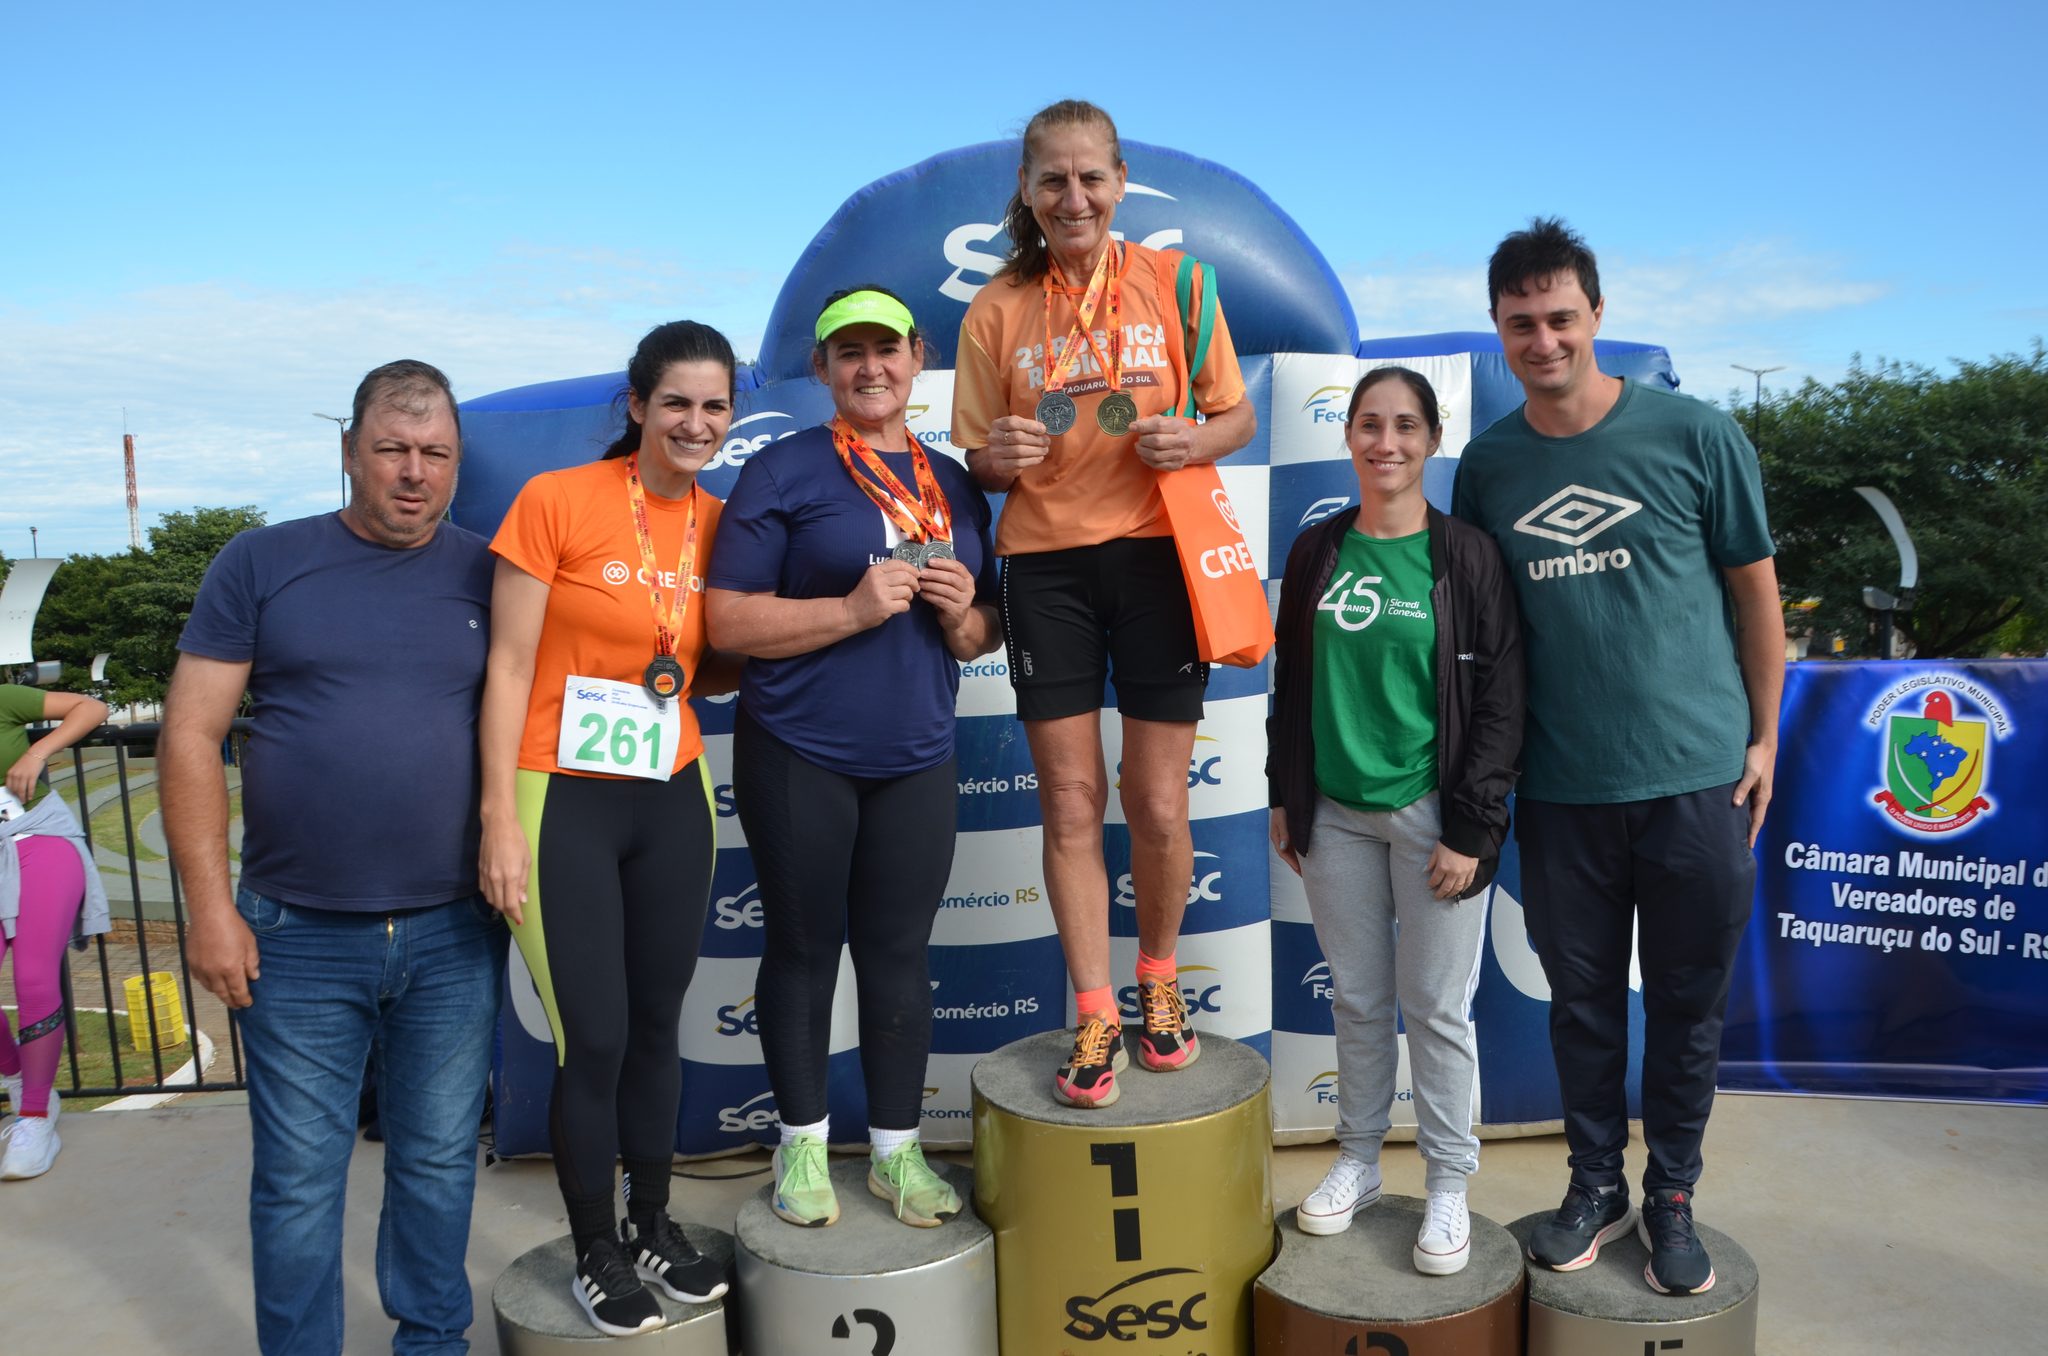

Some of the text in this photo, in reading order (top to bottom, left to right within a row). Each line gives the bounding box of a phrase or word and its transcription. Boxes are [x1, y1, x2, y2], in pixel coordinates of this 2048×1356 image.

[1135, 375, 1152, 383] SUL
[1528, 548, 1632, 581] umbro
[1344, 604, 1372, 614] ANOS
[1387, 607, 1427, 620] Conexão
[1389, 598, 1420, 609] Sicredi
[1869, 676, 2009, 735] PODER LEGISLATIVO MUNICIPAL
[575, 712, 661, 770] 261
[1015, 773, 1039, 791] RS
[1785, 841, 1891, 876] Câmara
[1897, 850, 2027, 890] Municipal
[1015, 886, 1040, 904] RS
[1831, 881, 2017, 921] Vereadores de
[1777, 912, 1914, 954] Taquaruçu
[1920, 925, 1952, 953] do
[1959, 927, 2001, 956] Sul
[1014, 997, 1040, 1015] RS
[1090, 1141, 1142, 1263] 1
